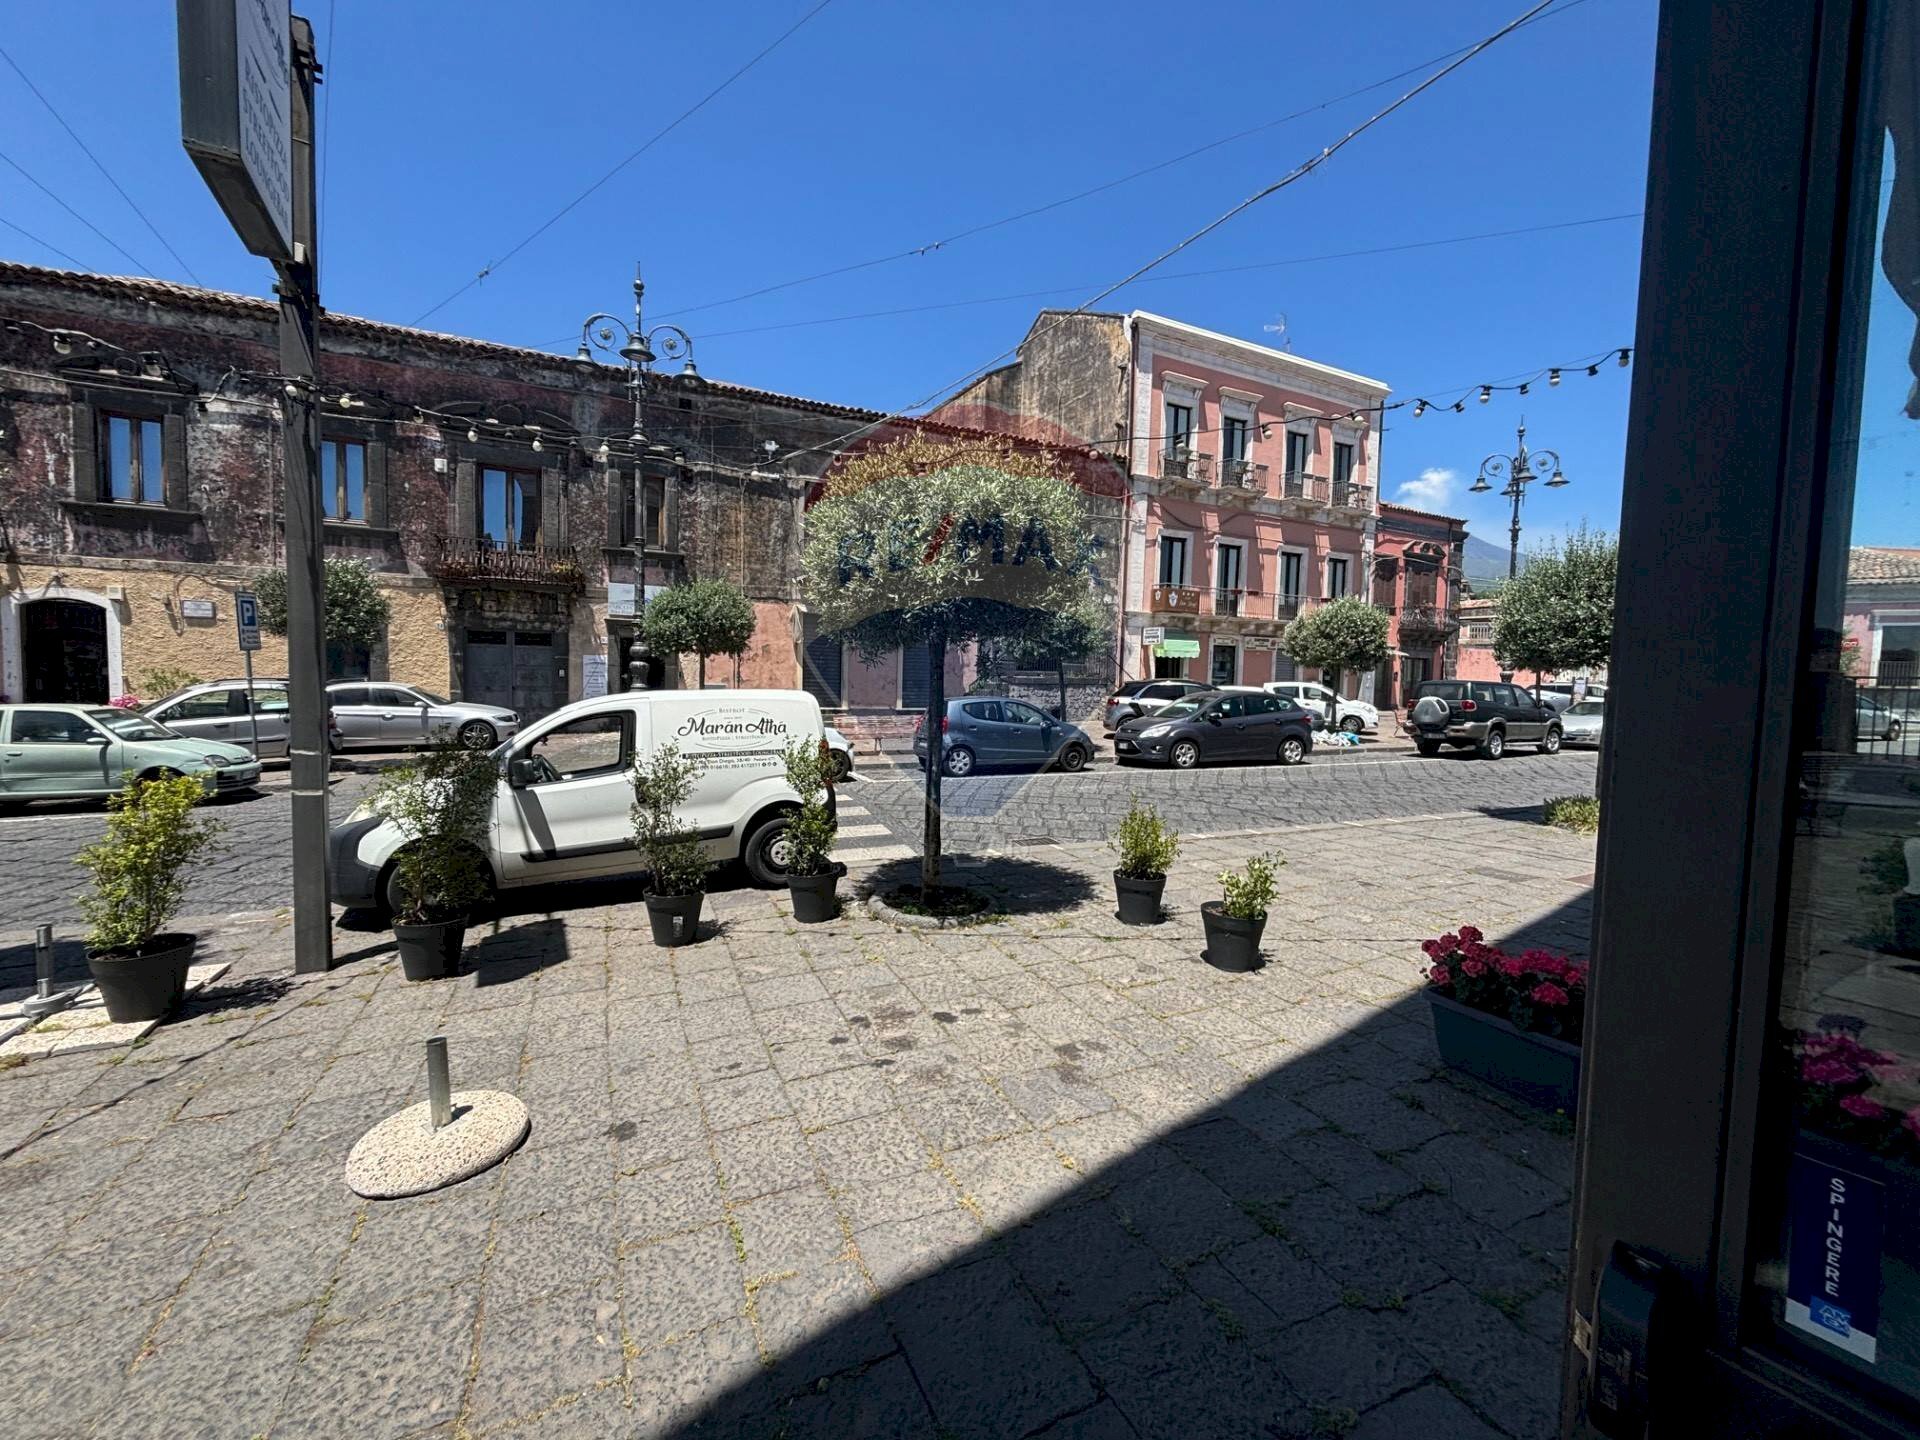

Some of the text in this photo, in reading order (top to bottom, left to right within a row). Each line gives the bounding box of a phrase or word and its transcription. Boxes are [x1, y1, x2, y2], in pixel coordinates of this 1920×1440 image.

[242, 603, 253, 625] P
[678, 717, 787, 736] Marán Athá
[1825, 1178, 1846, 1297] SPINGERE
